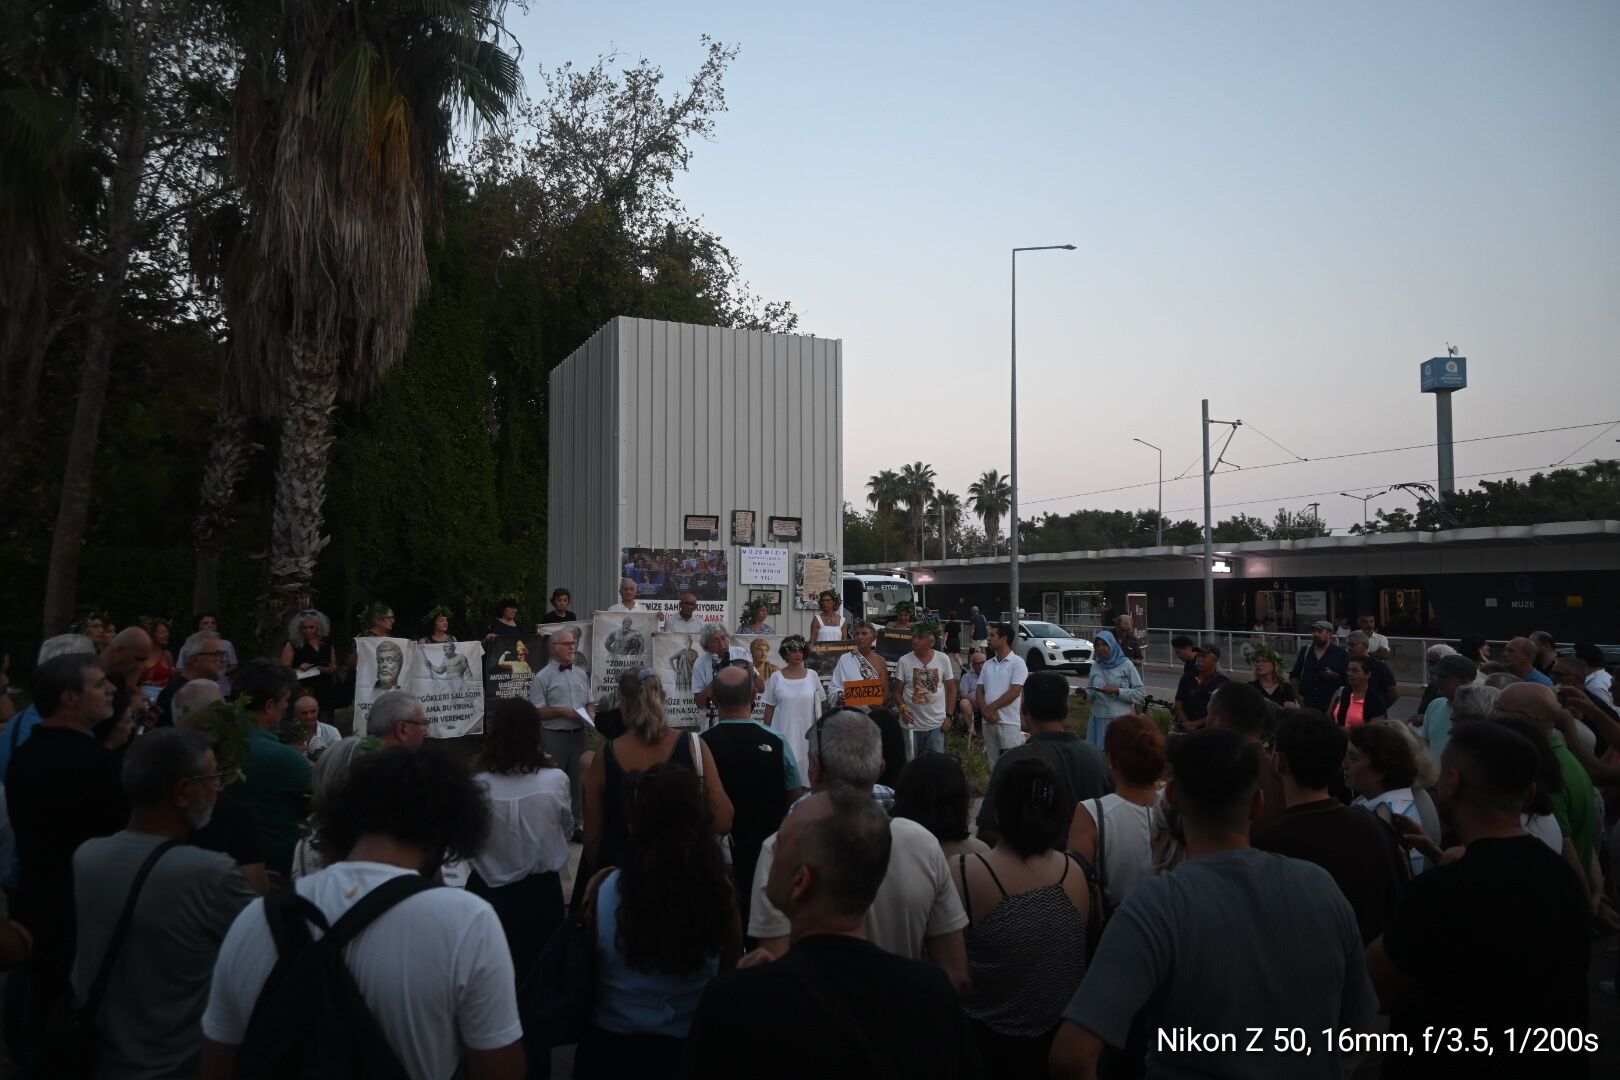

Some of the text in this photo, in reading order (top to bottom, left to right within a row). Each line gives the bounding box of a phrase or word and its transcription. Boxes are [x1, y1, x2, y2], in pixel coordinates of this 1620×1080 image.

[1511, 599, 1536, 608] MÜZE
[426, 705, 441, 713] AMA
[442, 704, 452, 712] BU
